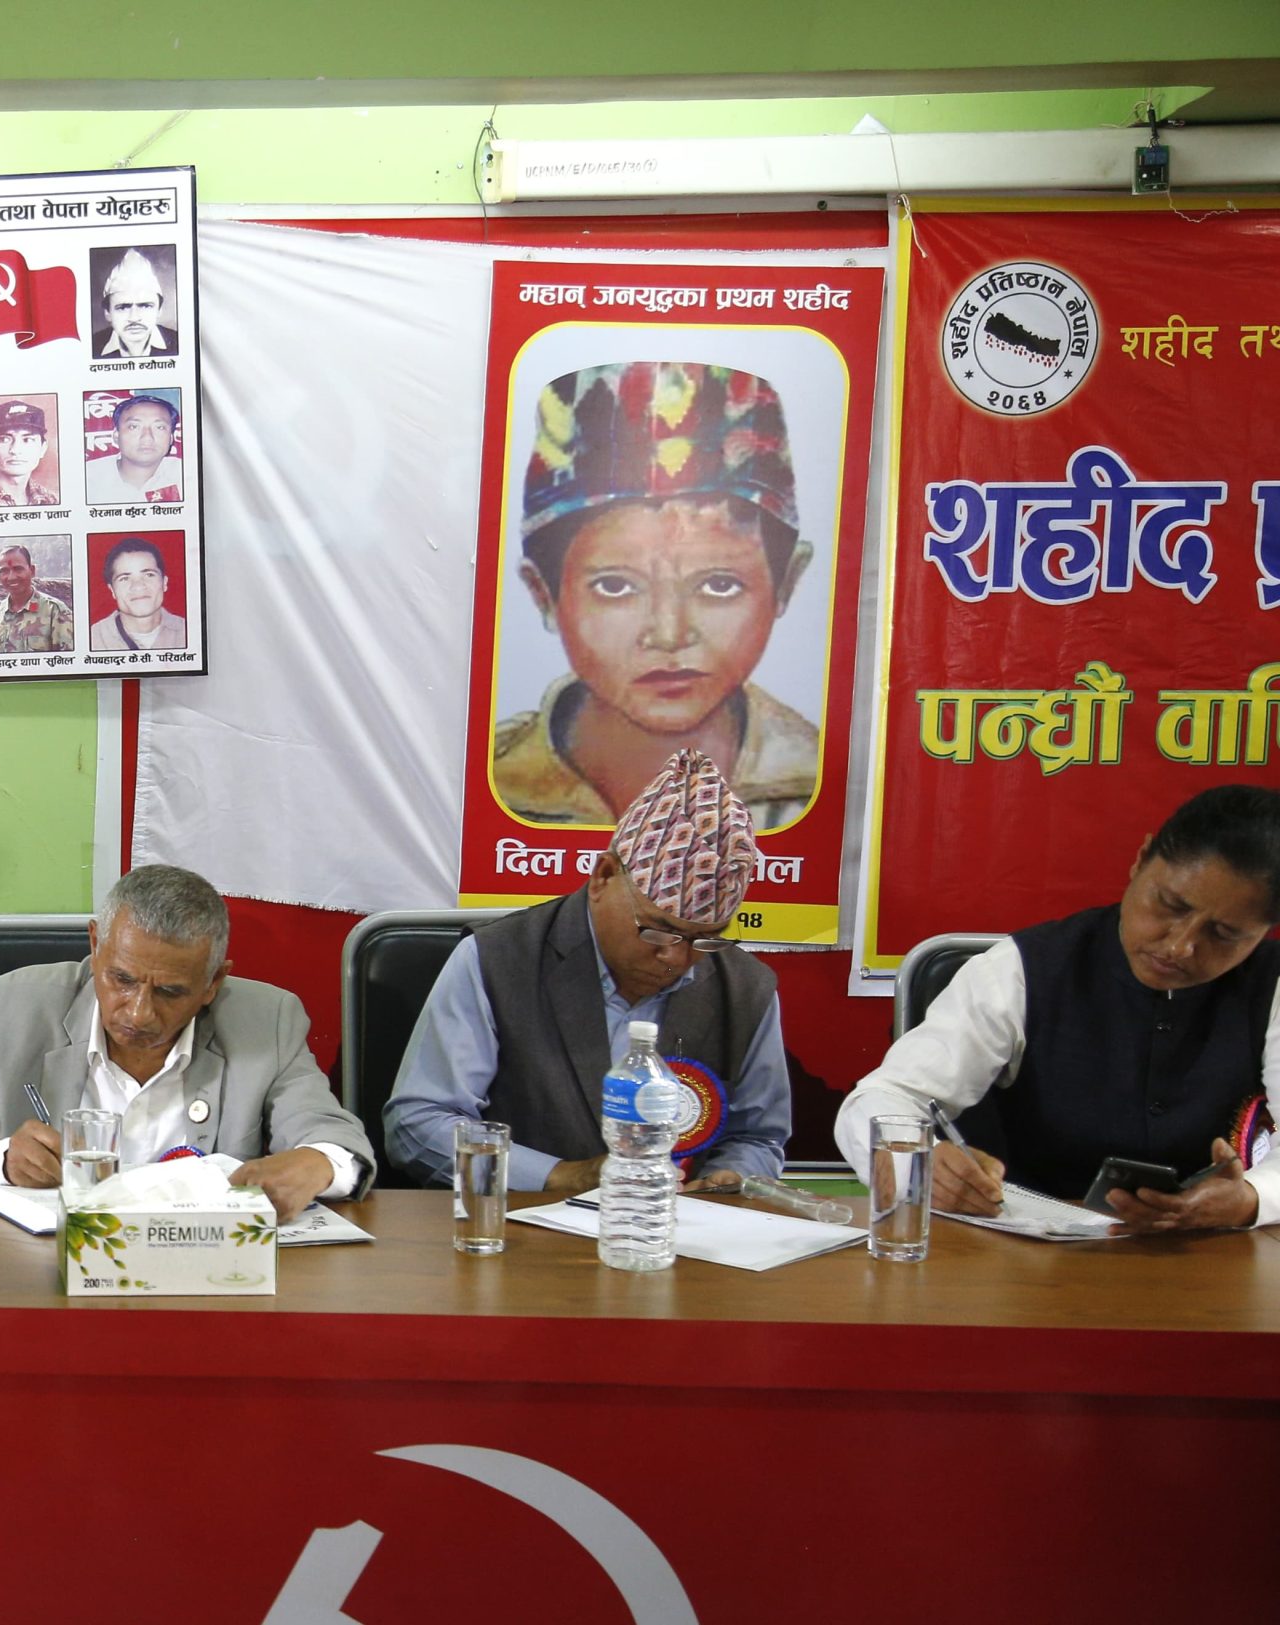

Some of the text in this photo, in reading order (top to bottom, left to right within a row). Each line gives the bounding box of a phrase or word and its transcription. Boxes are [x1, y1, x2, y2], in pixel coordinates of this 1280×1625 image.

[42, 199, 89, 219] वेपत्ता
[519, 283, 852, 313] महान् जनयुद्धका प्रथम शहीद
[950, 271, 1090, 360] शहीद प्रतिष्ठान नेपाल
[1120, 314, 1220, 367] शहीद
[987, 390, 1047, 411] २०६४
[923, 444, 1228, 606] शहीद
[20, 658, 41, 667] थापा
[495, 837, 566, 876] दिल
[147, 1226, 225, 1242] PREMIUM
[84, 1278, 100, 1288] 200
